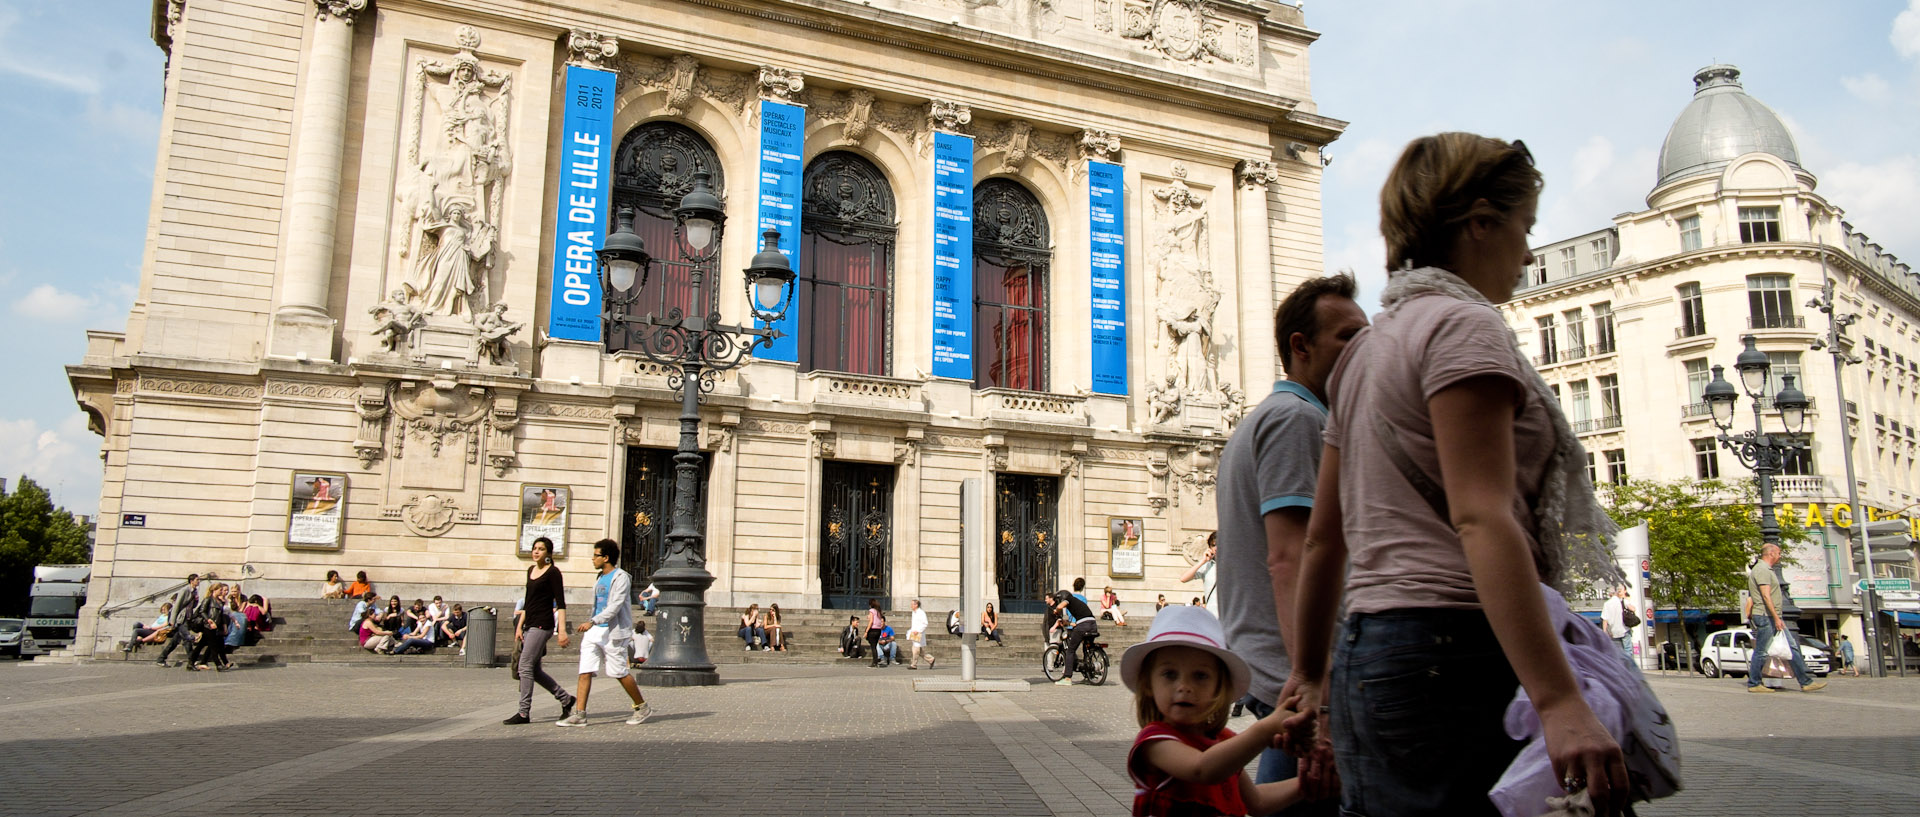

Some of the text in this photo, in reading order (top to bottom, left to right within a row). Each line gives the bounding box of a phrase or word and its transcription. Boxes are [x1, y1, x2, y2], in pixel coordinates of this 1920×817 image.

[577, 84, 589, 108] 2011
[591, 85, 603, 110] 2012
[764, 119, 797, 131] SPECTACLES
[763, 126, 792, 137] MUSICAUX
[936, 142, 952, 151] DANSE
[1091, 170, 1113, 179] CONCERTS
[563, 131, 601, 306] OPERA DE LILLE
[935, 276, 951, 284] HAPPY
